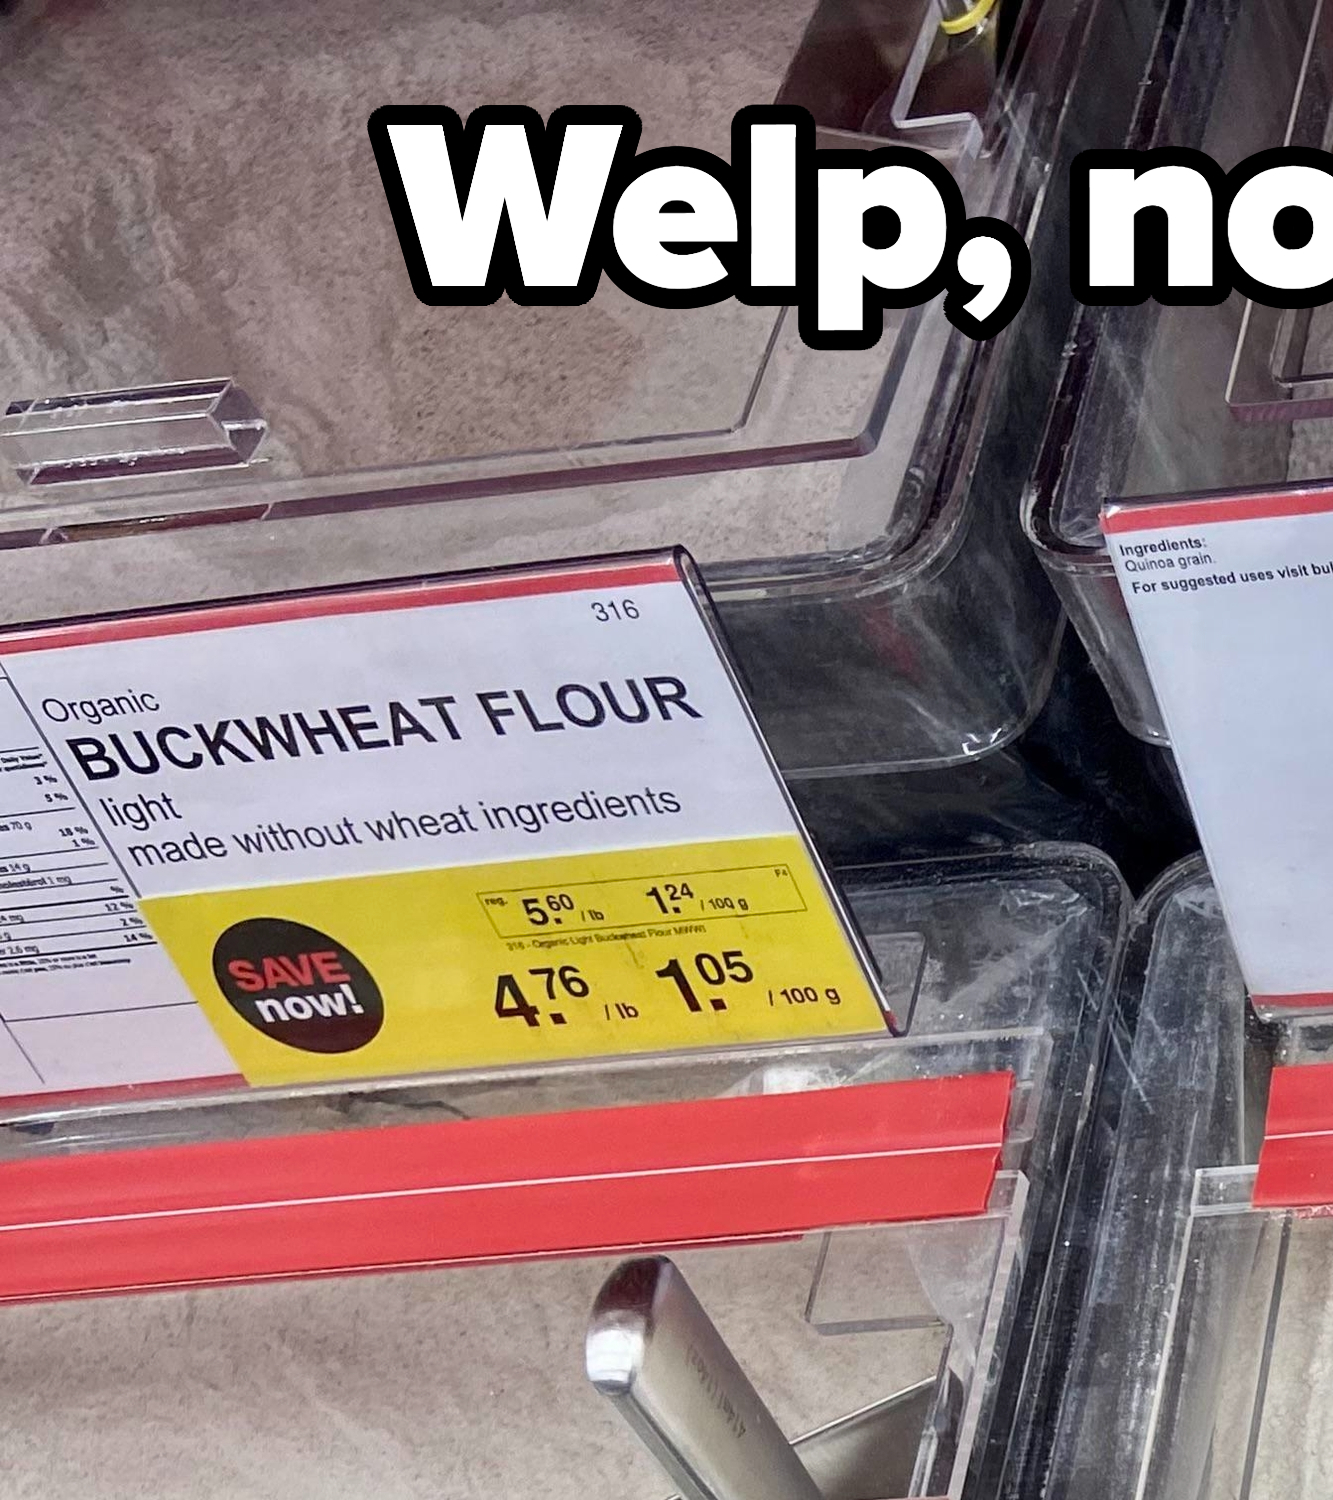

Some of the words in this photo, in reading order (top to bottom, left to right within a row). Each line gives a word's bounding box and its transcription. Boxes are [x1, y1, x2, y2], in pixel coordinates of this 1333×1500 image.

[1118, 537, 1206, 557] Ingredients:
[1124, 557, 1175, 572] Quinoa
[1177, 551, 1215, 569] grain.
[1131, 581, 1156, 594] For
[1160, 571, 1236, 591] suggested
[1239, 570, 1274, 582] uses
[1276, 563, 1309, 578] visit
[592, 600, 639, 621] 316
[43, 690, 159, 724] Organic
[67, 693, 461, 782] BUCKWHEAT
[476, 677, 702, 735] FLOUR
[100, 793, 182, 830] light
[128, 832, 227, 866] made
[233, 816, 382, 854] without
[369, 804, 478, 842] wheat
[483, 788, 680, 833] ingredients
[588, 910, 604, 920] lb
[709, 898, 735, 909] 100
[738, 899, 748, 910] g
[226, 951, 351, 992] SAVE
[255, 986, 362, 1023] now!
[780, 987, 818, 1004] 100
[825, 989, 840, 1004] g
[615, 1003, 638, 1019] lb
